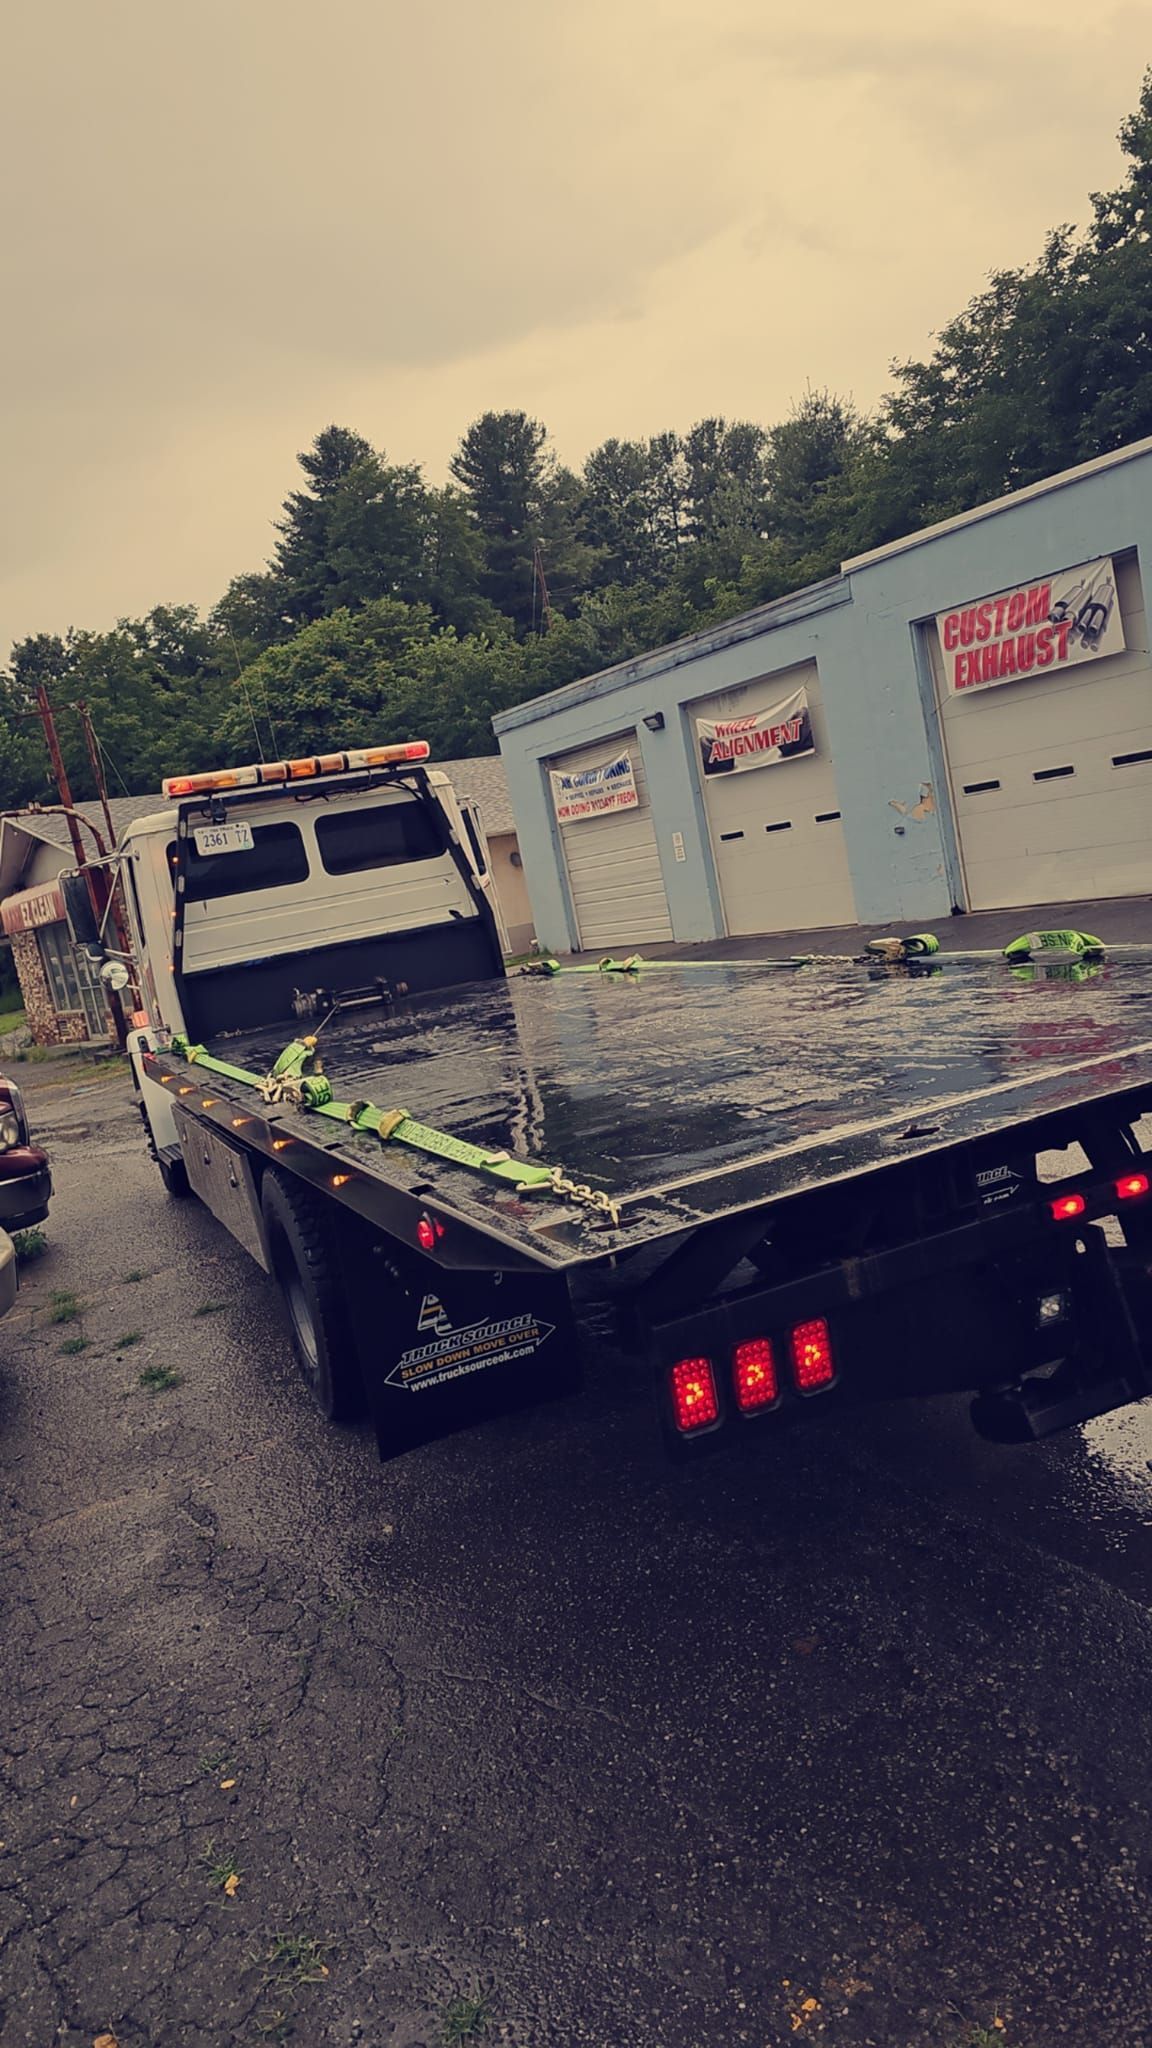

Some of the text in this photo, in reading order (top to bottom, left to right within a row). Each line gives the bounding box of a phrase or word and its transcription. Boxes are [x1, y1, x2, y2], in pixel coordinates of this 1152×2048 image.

[943, 582, 1052, 652] CUSTOM
[954, 619, 1073, 690] EXHAUST
[709, 718, 803, 764] ALIGNMENT
[714, 716, 758, 738] WHEEL
[571, 801, 591, 815] DOING
[616, 790, 636, 806] FREON
[202, 832, 228, 848] 2361
[31, 893, 58, 926] CLEAN
[401, 1313, 533, 1366] TRUCK SOURCE
[401, 1328, 540, 1380] SLOW DOWN MOVE OVER
[410, 1344, 535, 1393] www.trucksourceok.com
